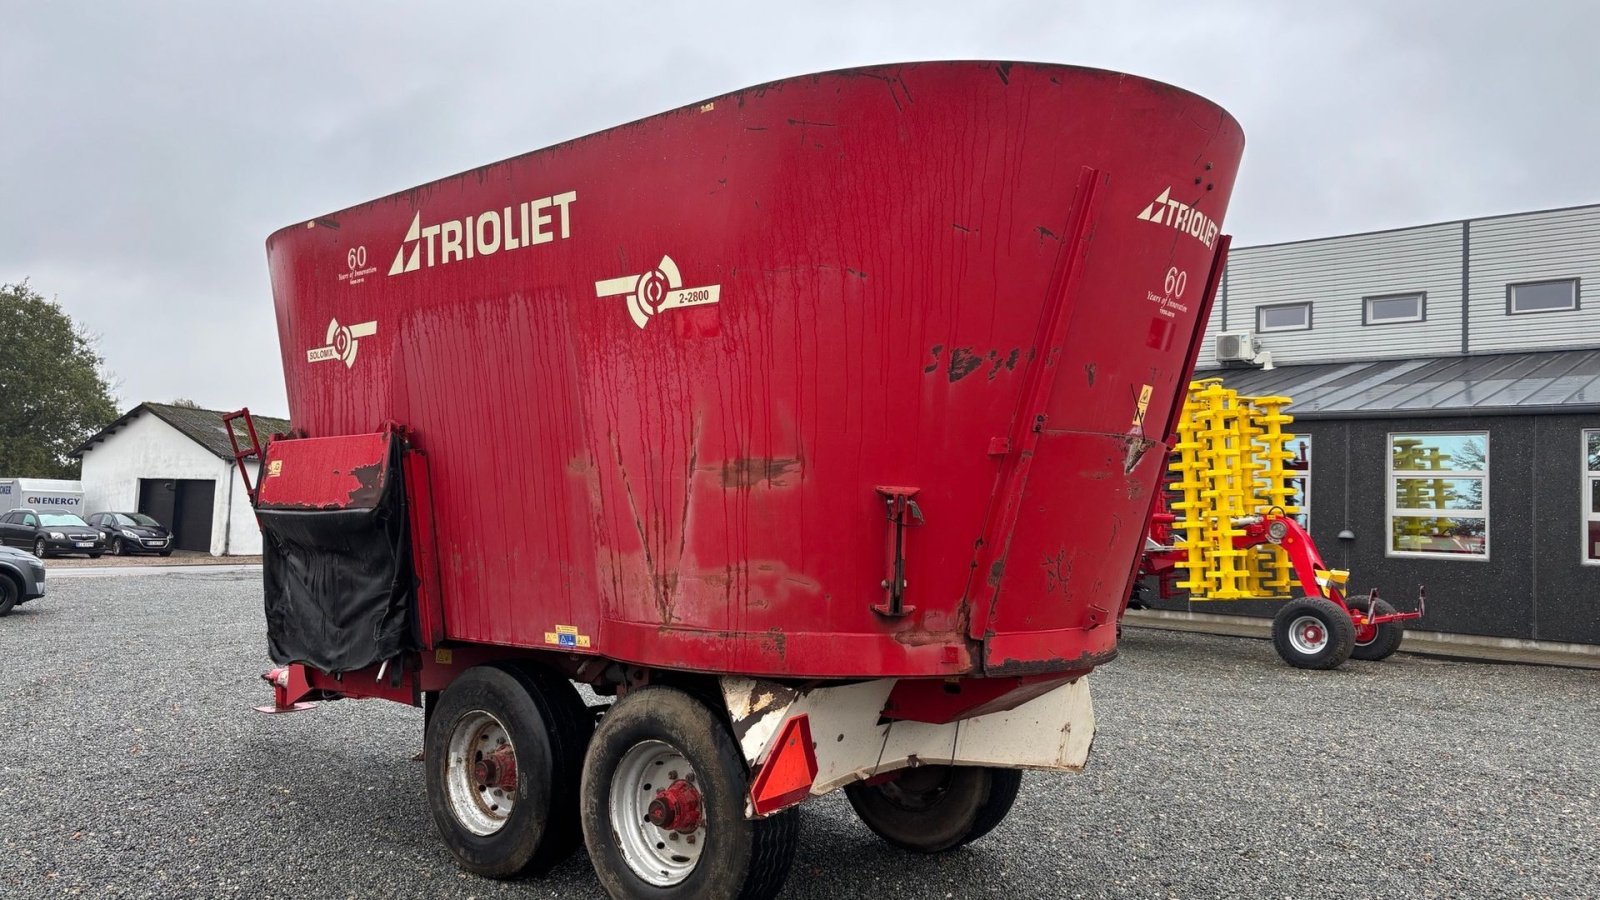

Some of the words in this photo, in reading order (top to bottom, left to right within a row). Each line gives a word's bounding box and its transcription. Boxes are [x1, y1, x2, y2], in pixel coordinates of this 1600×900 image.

[421, 190, 577, 267] TRIOLIET
[1166, 199, 1218, 251] TRIOLIET
[347, 245, 367, 269] 60
[1165, 266, 1187, 297] 60
[679, 290, 709, 303] 2-2800
[309, 349, 334, 360] SOLOMIX
[42, 497, 80, 506] ENERGY
